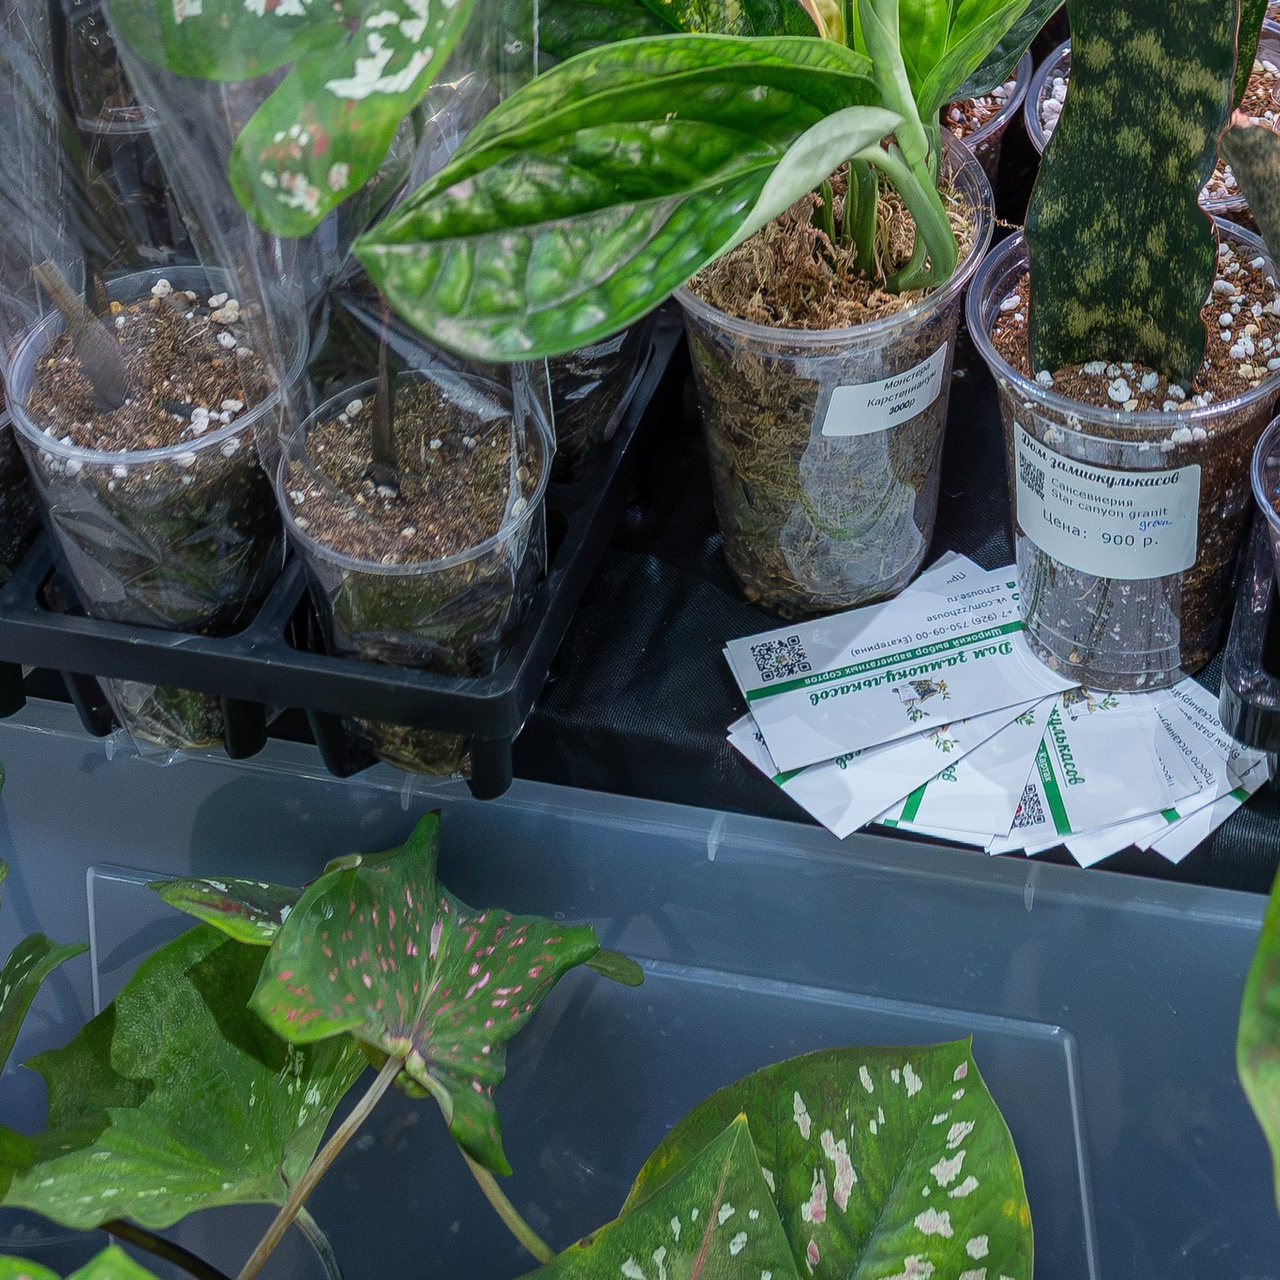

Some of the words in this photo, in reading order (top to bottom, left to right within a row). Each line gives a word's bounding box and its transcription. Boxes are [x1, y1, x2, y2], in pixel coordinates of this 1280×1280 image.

[867, 370, 937, 408] Карстенианум
[884, 362, 932, 392] Монстера
[889, 398, 916, 416] 3000р
[1021, 432, 1048, 463] Дом
[1050, 457, 1181, 489] замиокулькасов
[1051, 477, 1134, 509] Сансевиерия
[1051, 488, 1075, 507] Star
[1078, 502, 1125, 520] canyon
[1129, 507, 1168, 521] granit
[1042, 508, 1089, 541] Цена:
[1101, 532, 1135, 547] 900
[1143, 536, 1160, 550] р.
[947, 584, 1001, 604] zzhouse.ru
[926, 596, 1008, 623] vk.com/zzhouse
[971, 612, 998, 626] (926)
[1002, 609, 1014, 619] +7
[915, 621, 970, 641] 750-09-00
[953, 628, 1002, 648] Широкий
[851, 634, 913, 658] (Екатерина)
[915, 641, 950, 657] выбор
[973, 641, 1014, 661] Дом
[845, 651, 913, 676] вариегатных
[804, 669, 843, 686] сортов
[809, 651, 968, 707] замиокулькасов
[1192, 721, 1217, 741] рады
[1050, 705, 1086, 785] кулькасов
[1191, 756, 1217, 787] Просто
